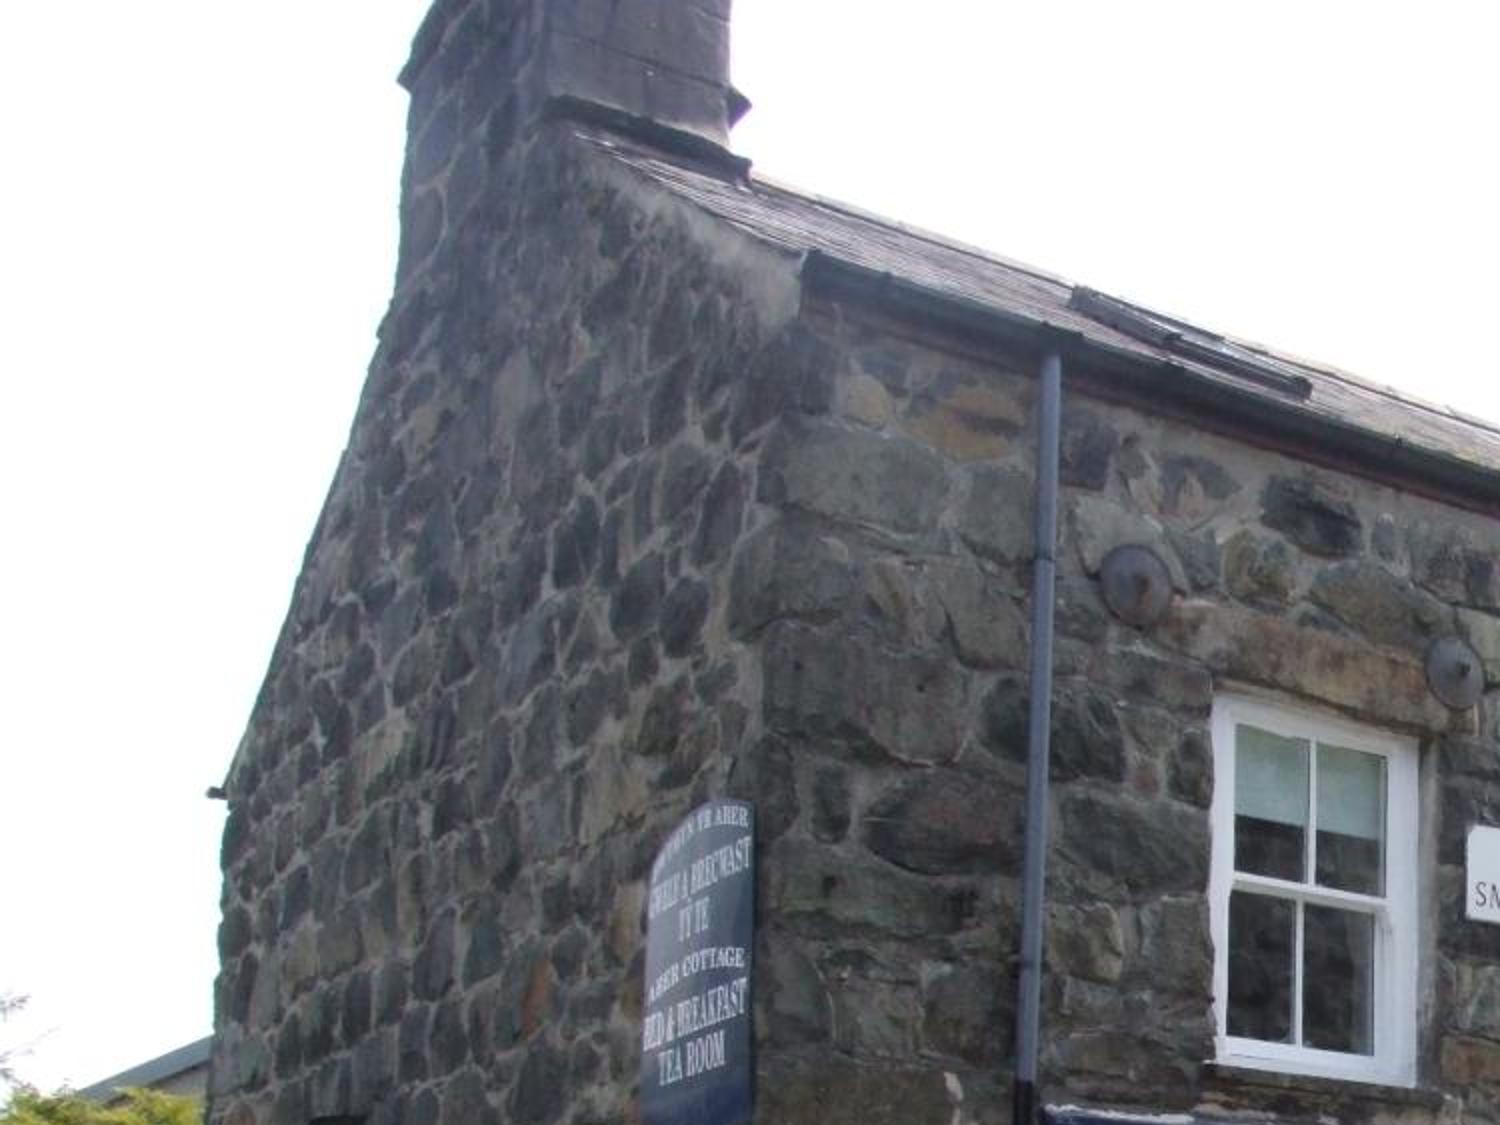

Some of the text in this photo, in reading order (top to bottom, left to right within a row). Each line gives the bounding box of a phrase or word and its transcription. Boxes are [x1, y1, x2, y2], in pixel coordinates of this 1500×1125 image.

[715, 805, 749, 829] ABER
[648, 946, 746, 1003] ABER COTTAGE
[643, 1010, 665, 1052] BED
[677, 976, 748, 1037] BREAKFAST
[658, 1028, 726, 1087] TEA ROOM
